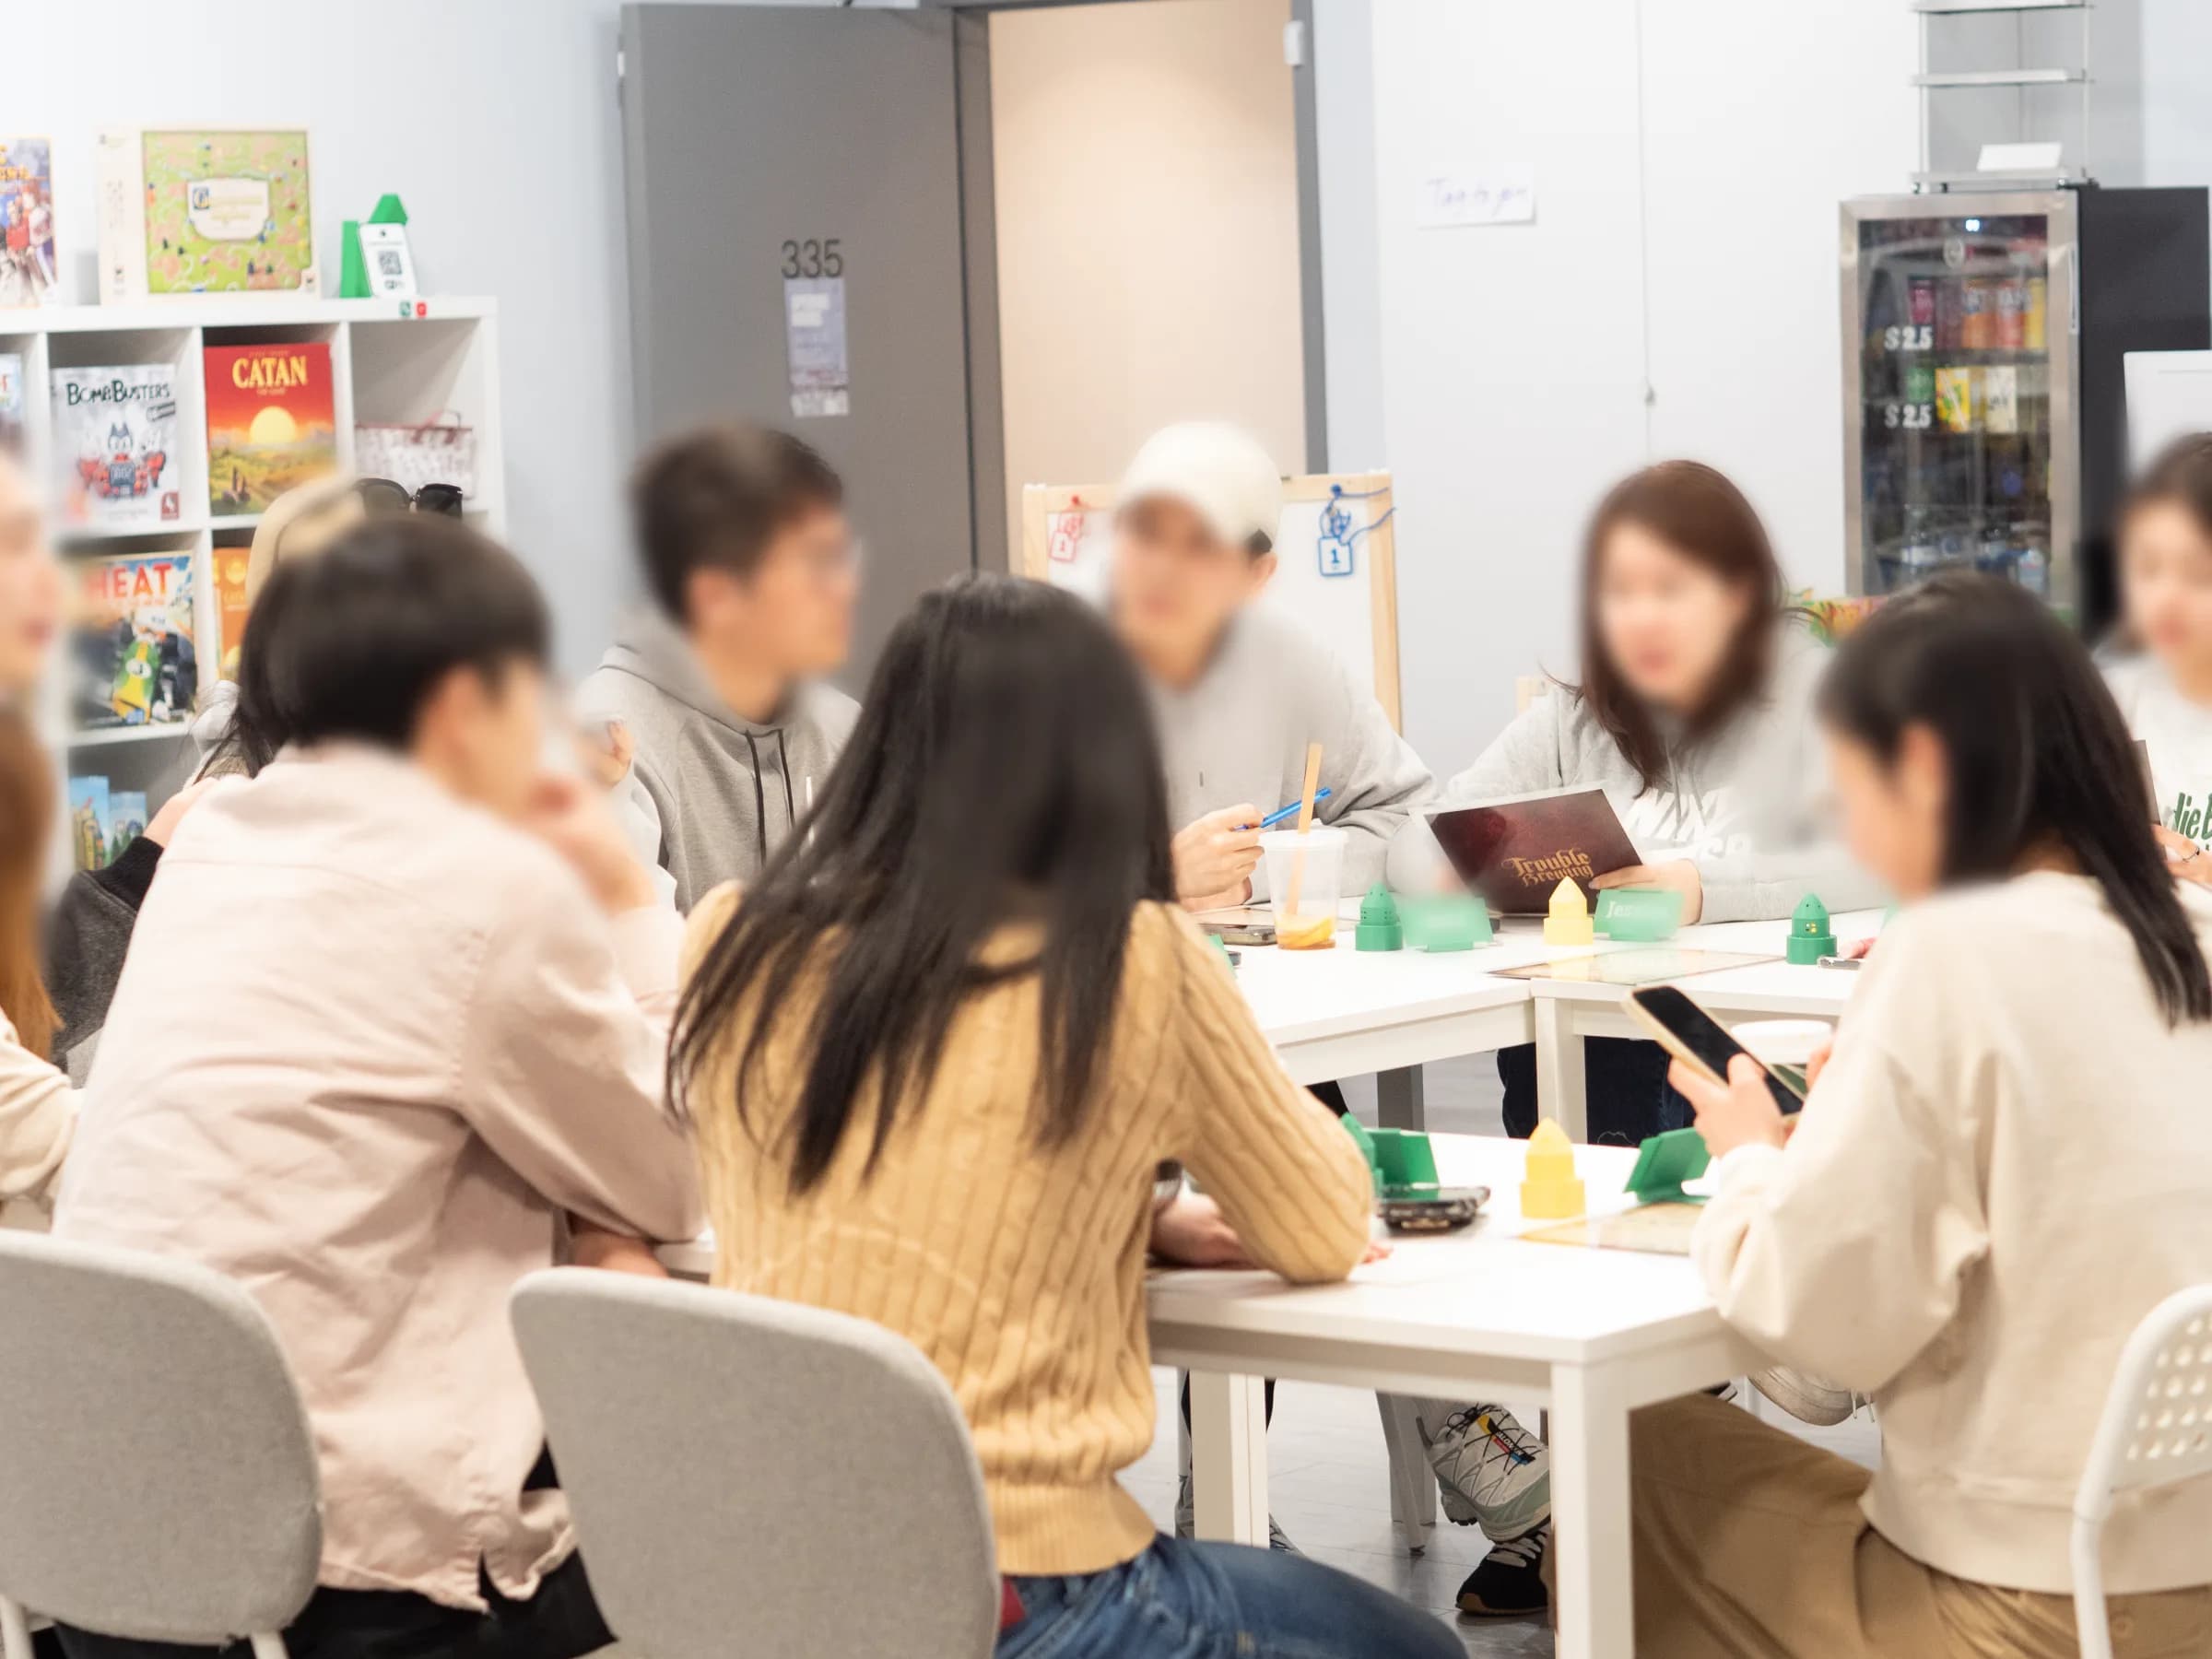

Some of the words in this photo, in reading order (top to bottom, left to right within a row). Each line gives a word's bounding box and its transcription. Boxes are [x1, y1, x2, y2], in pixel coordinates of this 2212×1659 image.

[782, 239, 842, 278] 335
[232, 356, 308, 389] CATAN
[88, 562, 172, 600] HEAT
[1501, 848, 1592, 878] Trouble
[1522, 865, 1594, 887] Brewing
